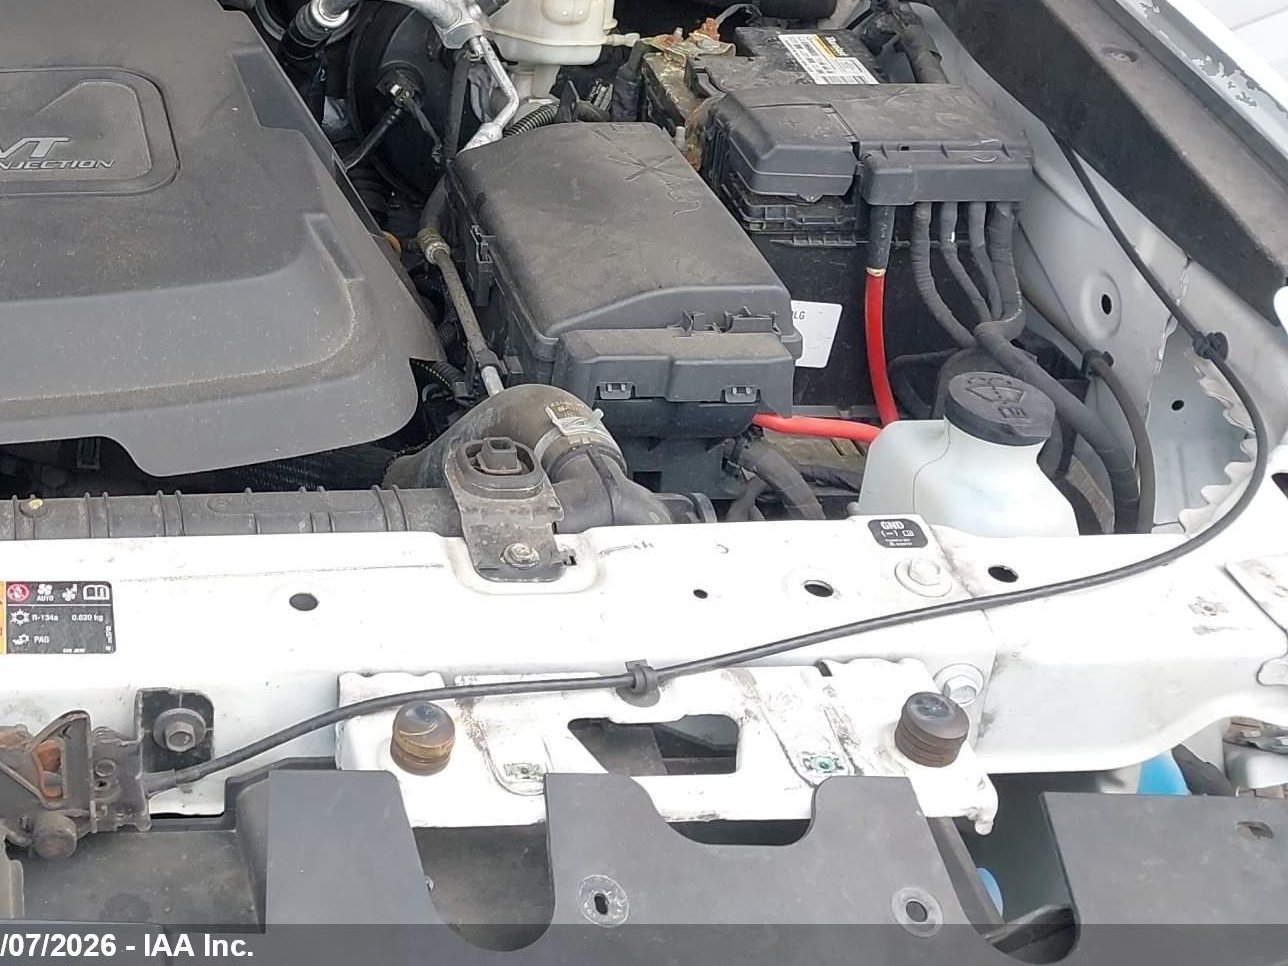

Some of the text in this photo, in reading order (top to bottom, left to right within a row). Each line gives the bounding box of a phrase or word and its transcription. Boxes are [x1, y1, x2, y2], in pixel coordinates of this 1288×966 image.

[792, 310, 806, 320] LG
[880, 521, 905, 530] GND
[31, 614, 59, 622] R-134a
[94, 613, 104, 623] kg
